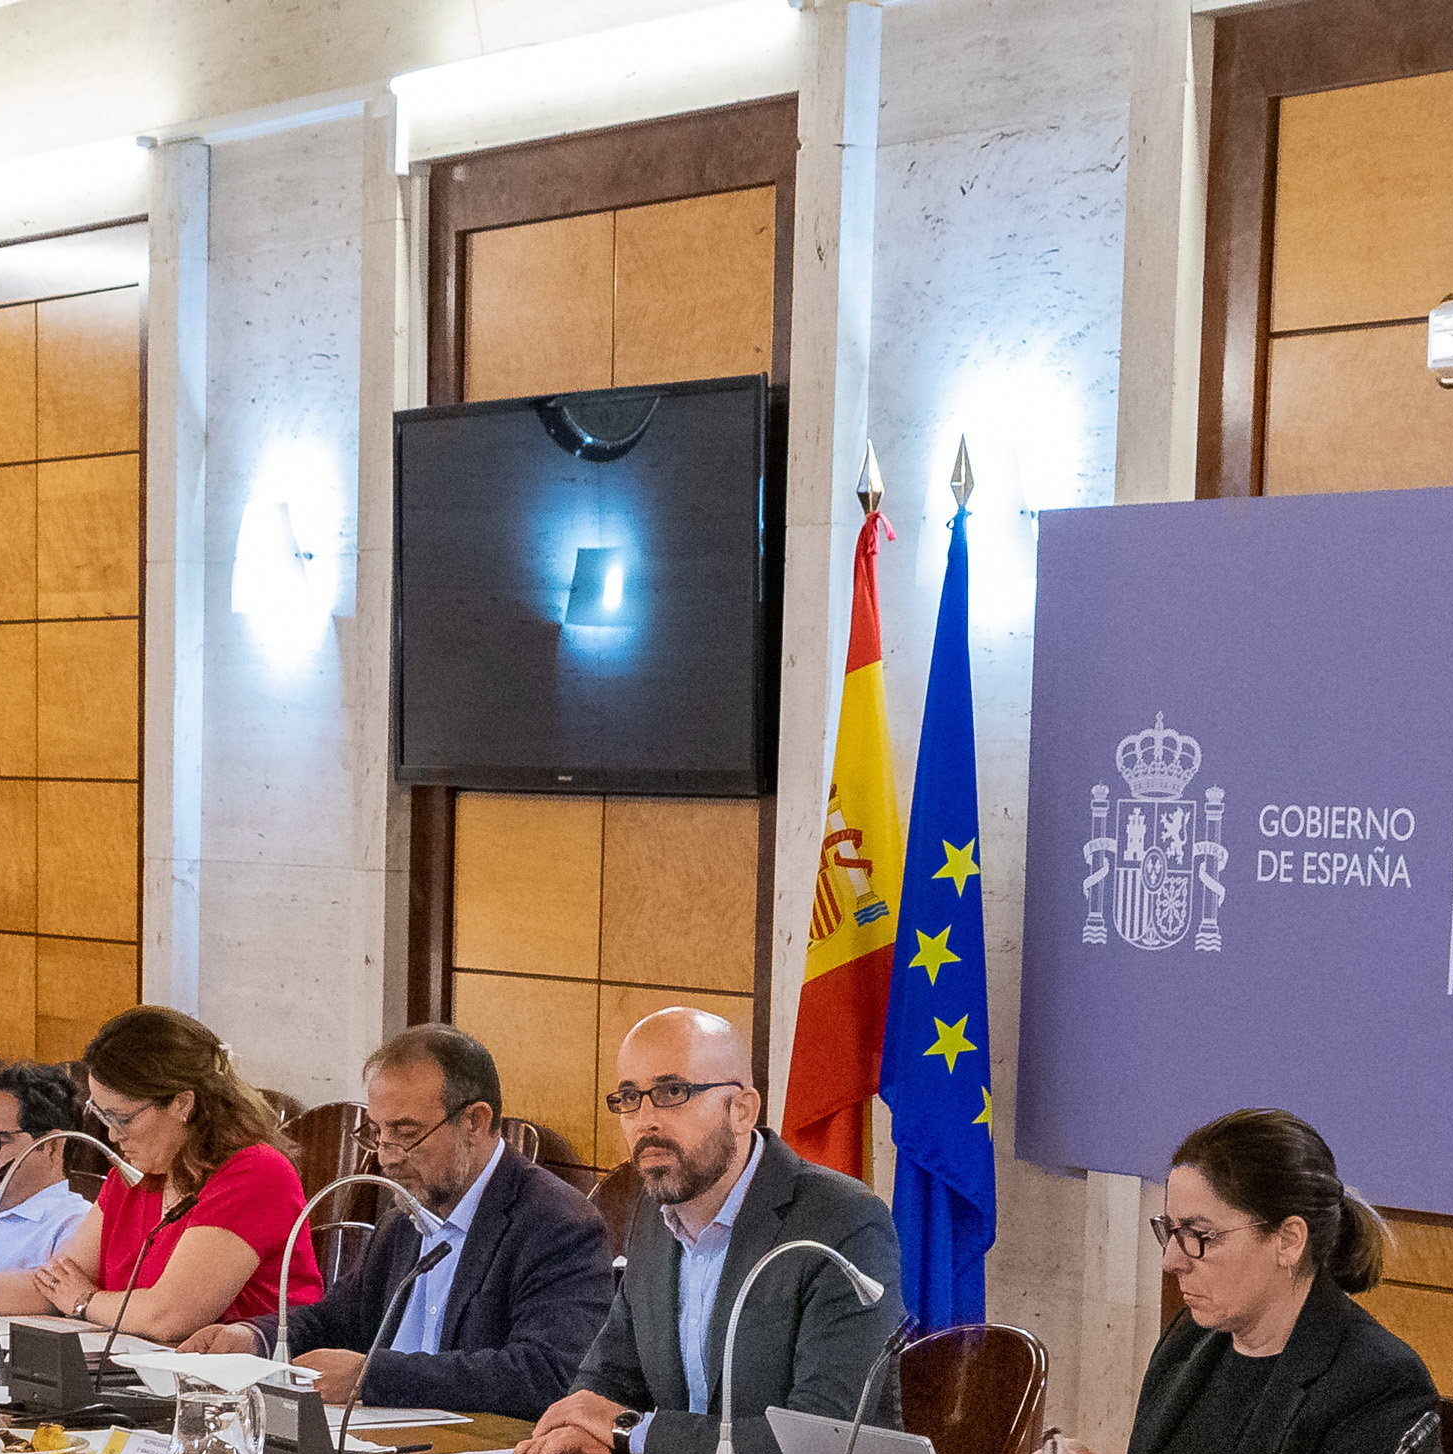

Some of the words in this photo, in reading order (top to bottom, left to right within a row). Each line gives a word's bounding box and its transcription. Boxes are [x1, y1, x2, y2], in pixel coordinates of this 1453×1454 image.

[1258, 804, 1416, 842] GOBIERNO
[1256, 849, 1294, 882] DE
[1303, 845, 1413, 888] ESPAÑA
